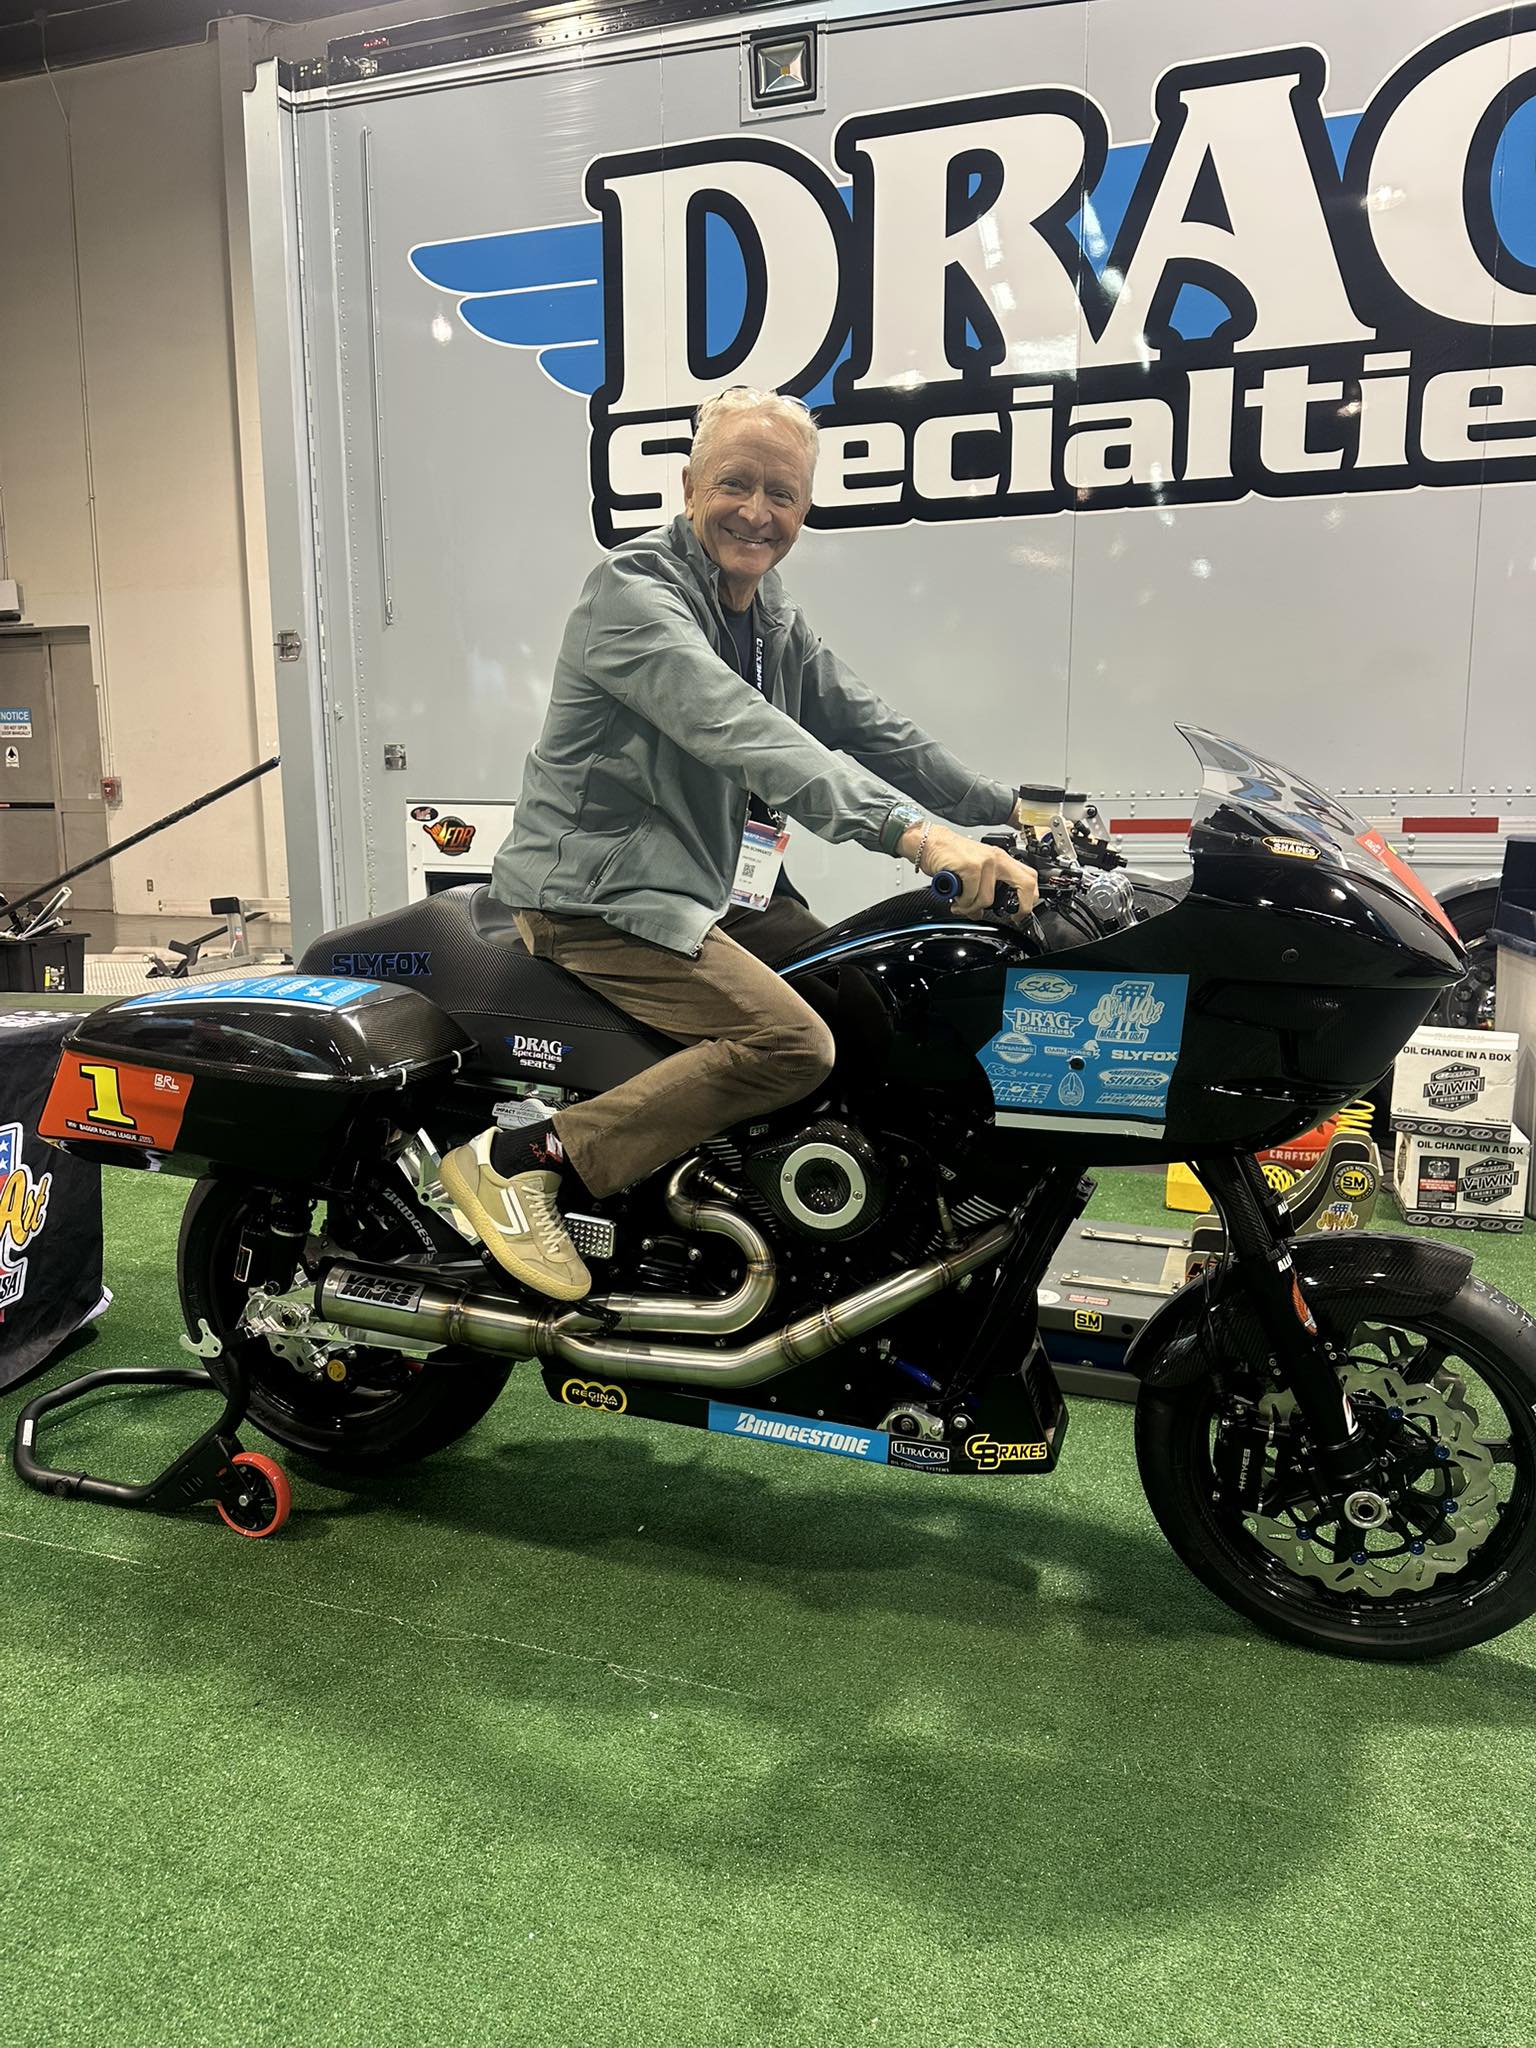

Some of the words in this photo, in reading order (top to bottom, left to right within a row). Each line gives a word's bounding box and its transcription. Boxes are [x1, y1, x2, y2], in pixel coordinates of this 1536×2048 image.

[608, 350, 1536, 529] Secialtie
[0, 711, 29, 720] NOTICE
[1273, 842, 1316, 856] SHADES
[332, 951, 432, 976] SLYFOX
[1024, 980, 1065, 993] S&S
[1016, 1010, 1070, 1029] DRAG
[513, 1035, 562, 1056] DRAG
[512, 1049, 562, 1062] Specialties
[1111, 1050, 1178, 1061] SLYFOX
[1403, 1046, 1418, 1055] OIL
[1420, 1048, 1464, 1058] CHANGE
[1479, 1052, 1487, 1060] A
[1489, 1053, 1512, 1062] BOX
[520, 1058, 556, 1070] seats
[1106, 1077, 1162, 1086] SHADES
[80, 1063, 136, 1128] 1
[1270, 1150, 1325, 1161] CRAFTSM
[1417, 1140, 1432, 1149] OIL
[1433, 1142, 1477, 1152] CHANGE
[1492, 1145, 1500, 1153] A
[1501, 1146, 1523, 1155] BOX
[1343, 1176, 1365, 1191] SM
[0, 1271, 18, 1299] SA
[346, 1274, 419, 1296] VANCE
[340, 1284, 412, 1307] HINES
[1077, 1314, 1100, 1330] SM
[572, 1388, 618, 1402] REGINA
[734, 1412, 871, 1455] BRIDGESTONE
[1239, 1448, 1250, 1492] HAYES
